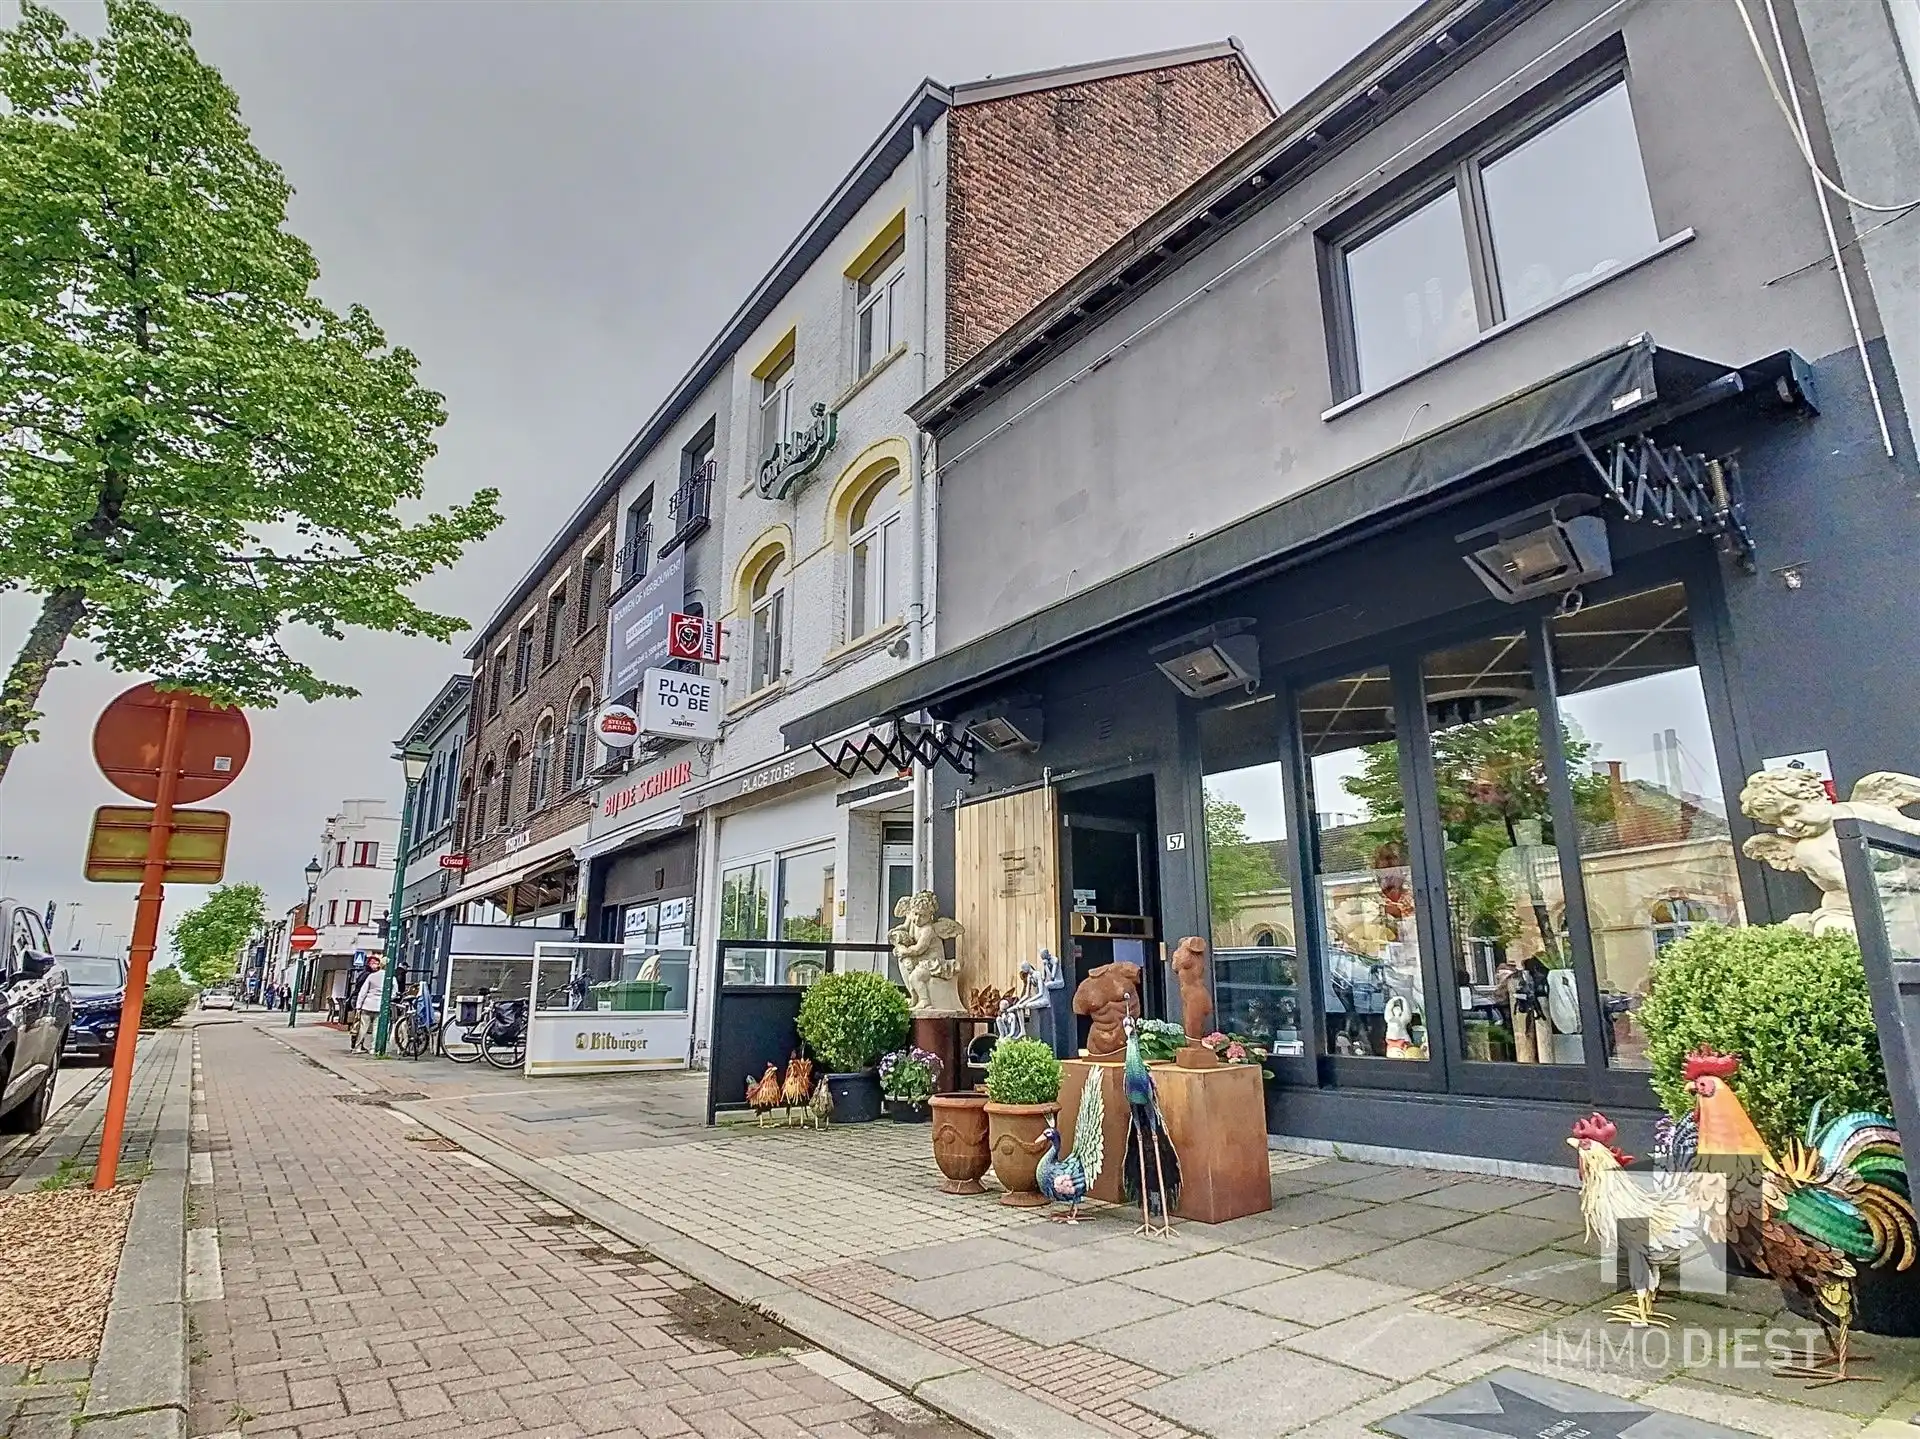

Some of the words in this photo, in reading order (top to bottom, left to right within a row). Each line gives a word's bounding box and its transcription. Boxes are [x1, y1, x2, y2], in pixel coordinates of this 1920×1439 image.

[703, 620, 714, 658] Jupiler
[659, 678, 711, 698] PLACE
[658, 692, 679, 707] TO
[688, 698, 709, 712] BE
[607, 719, 632, 727] STELLA
[607, 724, 632, 732] ARTOIS
[670, 718, 695, 728] Jupiler
[742, 772, 770, 793] PLACE
[770, 767, 782, 783] TO
[783, 762, 796, 779] BE
[604, 793, 621, 819] BIJ
[618, 785, 635, 811] DE
[635, 760, 692, 804] SCHUUR
[1170, 835, 1182, 849] 57
[590, 1031, 648, 1052] Bitburger
